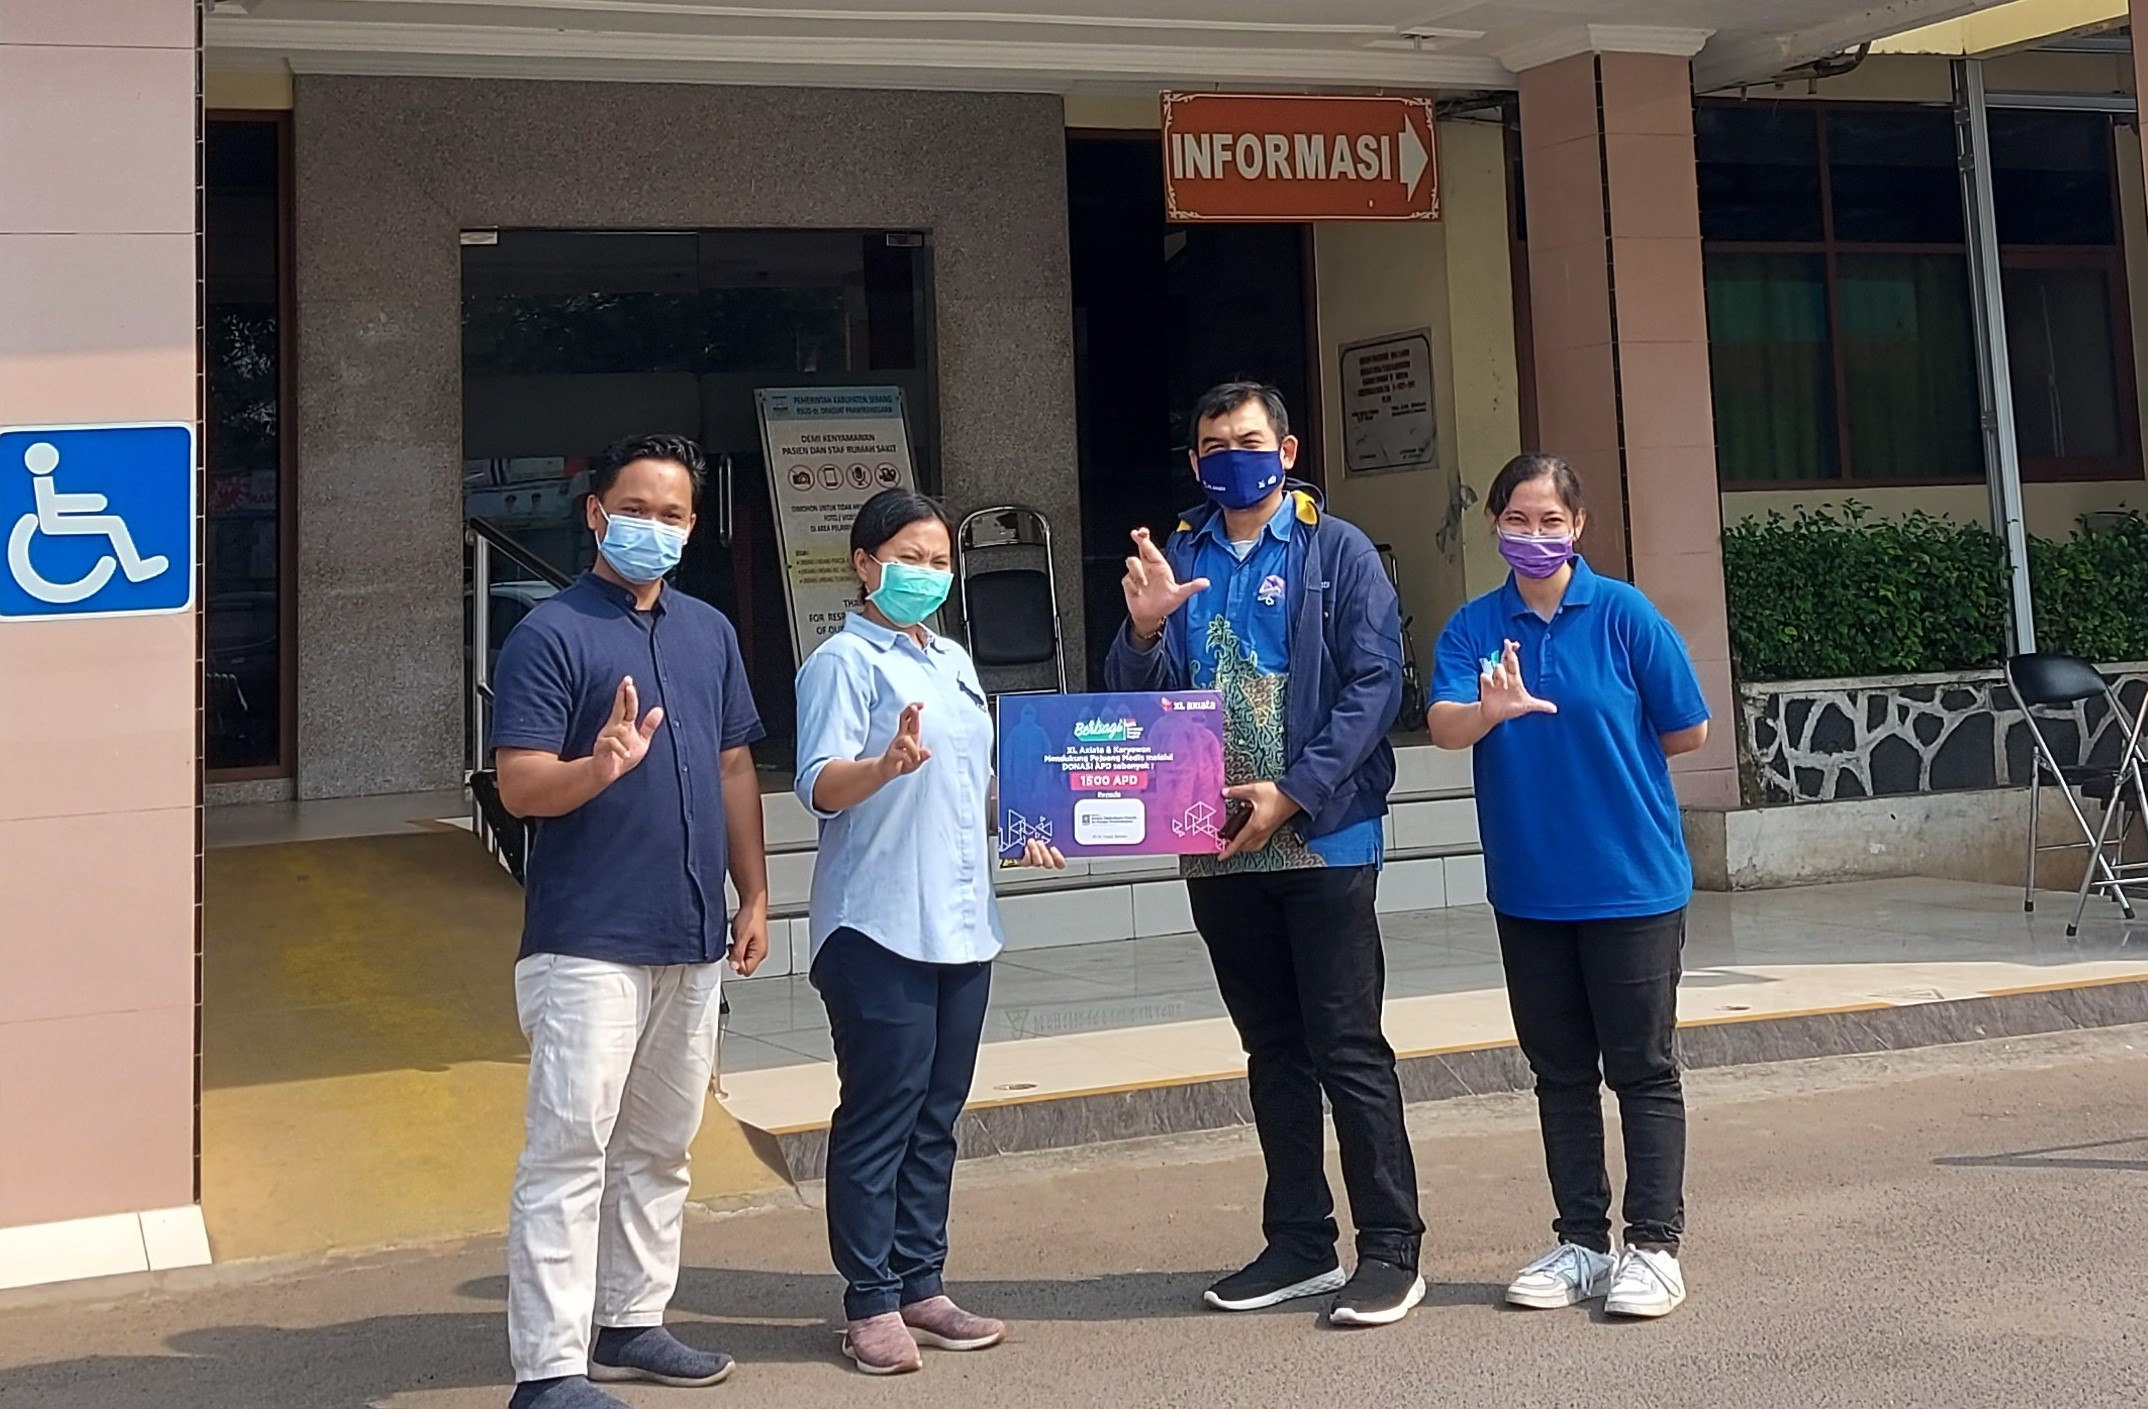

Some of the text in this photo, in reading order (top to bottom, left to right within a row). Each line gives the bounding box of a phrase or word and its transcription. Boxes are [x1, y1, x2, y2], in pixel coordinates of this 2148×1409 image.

[1172, 133, 1392, 181] INFORMASI
[793, 396, 832, 404] PEMERINTAH
[833, 395, 868, 403] KABUPATEN
[801, 434, 876, 443] DEMI KENYAMANAN
[782, 444, 897, 455] PASIEN DAN STAF RUMAH SAKIT
[791, 505, 818, 513] DIMOHON
[819, 504, 836, 512] UNTUK
[837, 503, 852, 511] TIDAK
[823, 514, 838, 522] FOTO
[810, 525, 817, 533] DI
[809, 613, 825, 622] FOR
[816, 625, 826, 635] OF
[1173, 701, 1186, 711] XL
[1073, 716, 1125, 740] Berbagi
[1066, 746, 1152, 755] XL Axiata & Karyawan
[1043, 754, 1089, 763] Mendukung
[1089, 754, 1121, 763] Pejuang
[1122, 754, 1145, 762] Medis
[1062, 763, 1094, 771] DONASI
[1095, 762, 1112, 770] APD
[1080, 774, 1138, 786] 1500 APD
